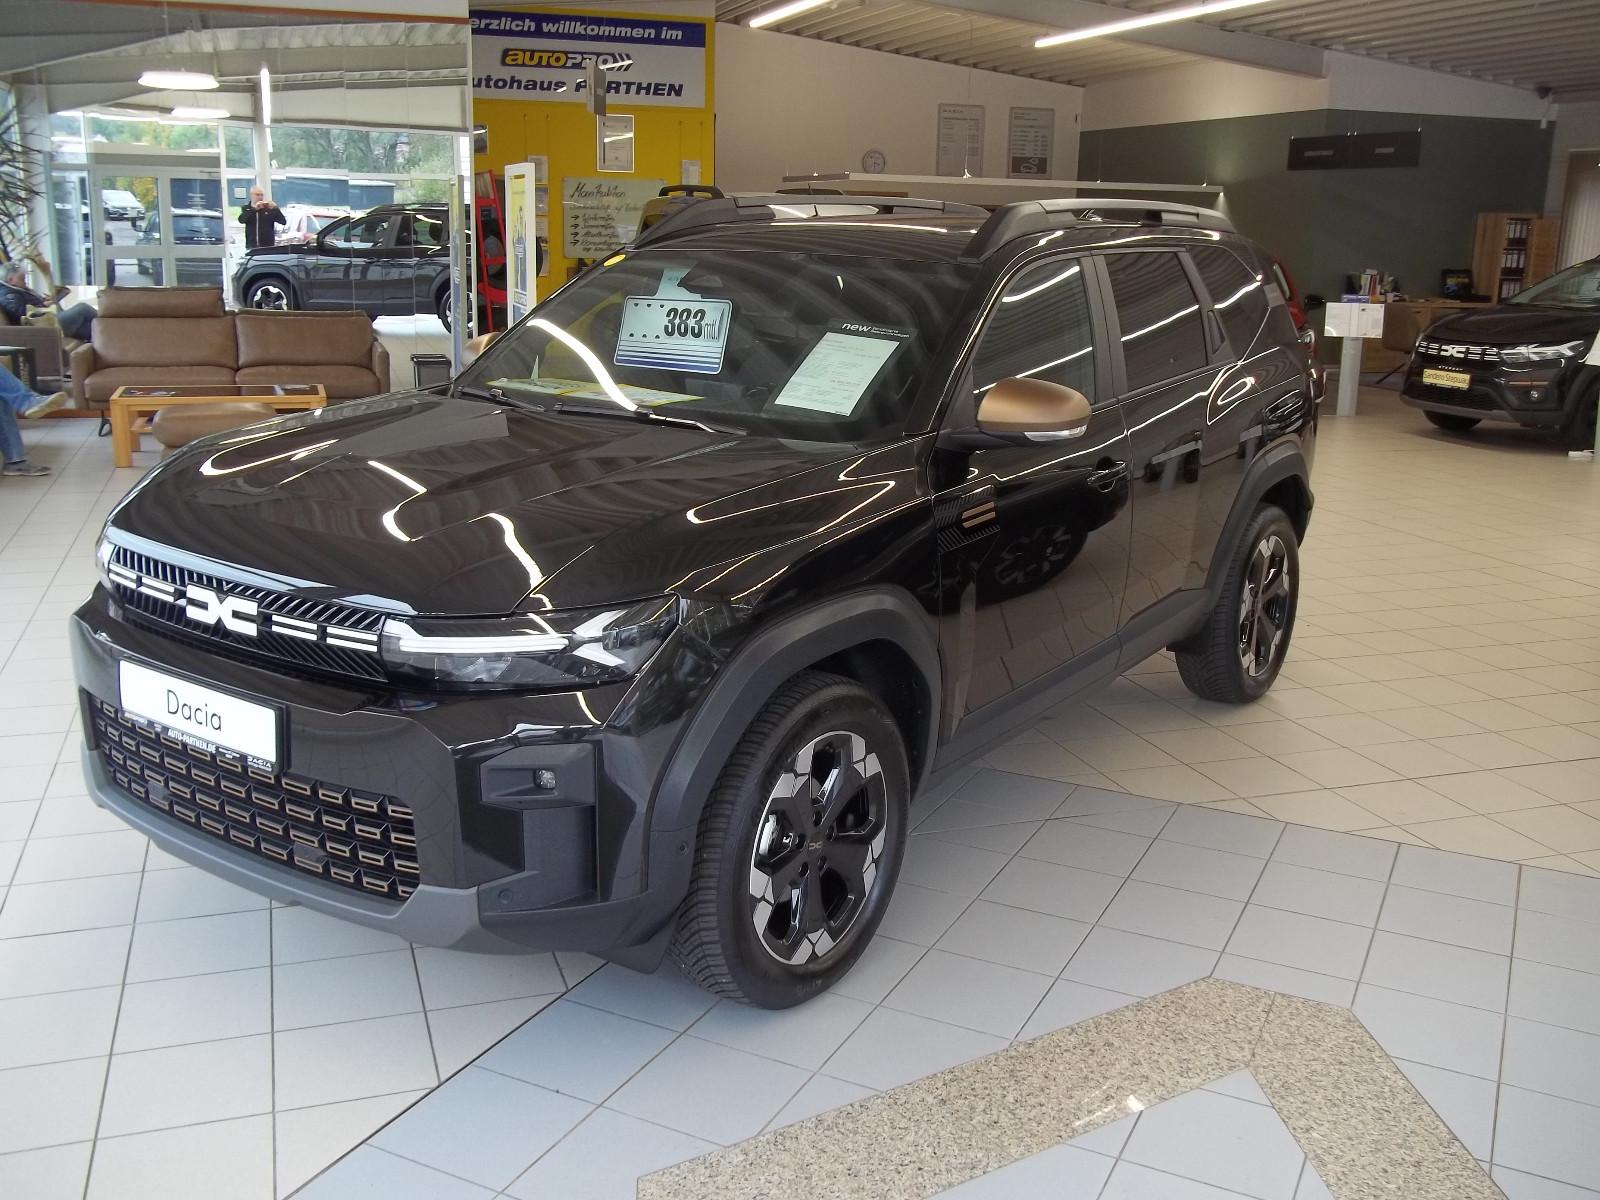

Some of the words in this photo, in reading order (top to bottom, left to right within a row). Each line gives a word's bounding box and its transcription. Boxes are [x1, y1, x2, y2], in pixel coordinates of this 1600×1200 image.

[470, 17, 536, 32] erzlich
[542, 20, 655, 39] willkommen
[661, 26, 683, 40] im
[472, 74, 567, 93] utohaus
[574, 79, 684, 97] PRTHEN
[664, 307, 706, 339] 383
[841, 323, 871, 332] new
[167, 689, 222, 732] Dacia
